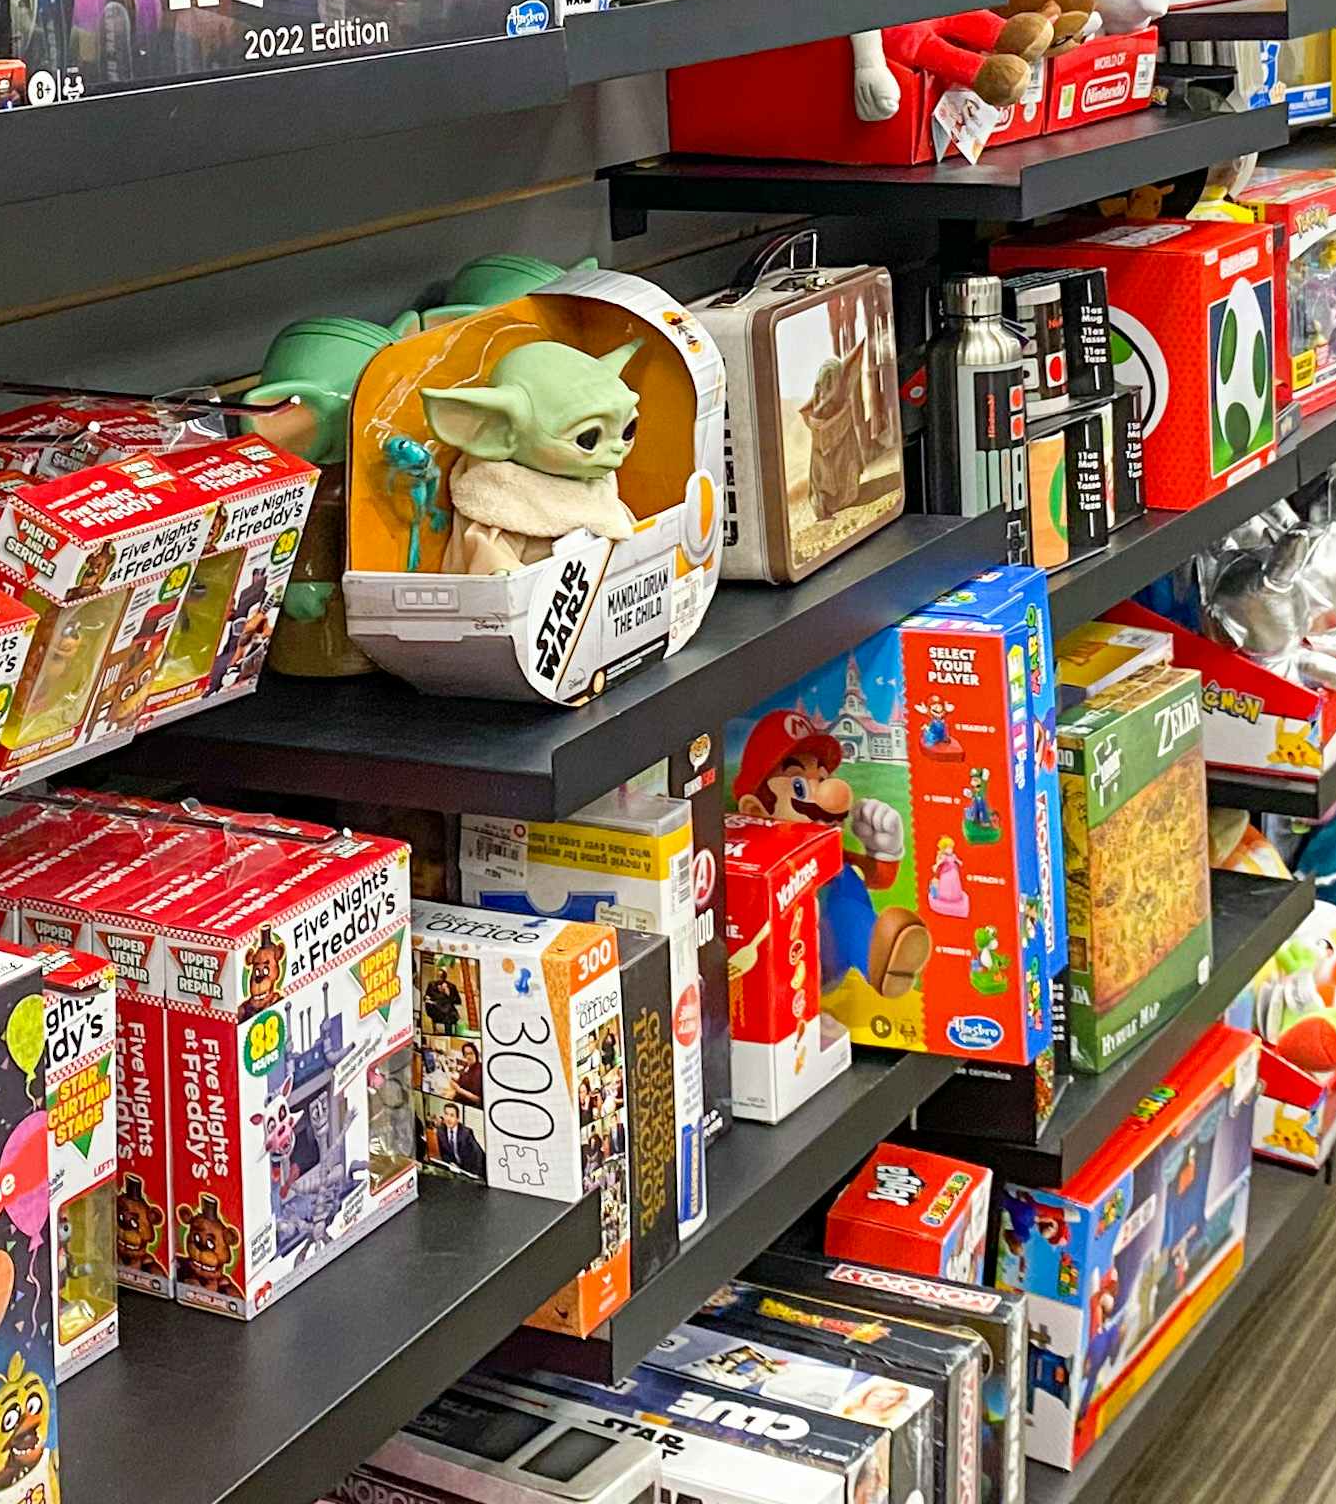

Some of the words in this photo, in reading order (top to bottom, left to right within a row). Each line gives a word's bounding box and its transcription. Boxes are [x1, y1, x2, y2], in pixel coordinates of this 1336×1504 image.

[244, 27, 306, 61] 2022
[310, 16, 389, 51] Edition
[1094, 56, 1111, 70] WORLD
[1112, 53, 1126, 66] OF
[1085, 76, 1129, 105] Nintendo
[1081, 314, 1103, 324] Mug
[1081, 335, 1106, 344] Tasse
[1084, 355, 1106, 363] Taza
[19, 519, 58, 550] PARTS
[5, 537, 56, 579] SERVICE
[607, 567, 669, 617] MANDALORIAN
[536, 560, 581, 672] STAR
[540, 566, 589, 680] WARS
[614, 610, 632, 637] THE
[635, 597, 662, 626] CHILD
[928, 647, 976, 662] SELECT
[945, 660, 973, 674] YOUR
[927, 671, 980, 687] PLAYER
[1155, 695, 1201, 757] ZELDA
[776, 859, 819, 908] Yahtzee
[293, 911, 330, 949] Five
[334, 868, 388, 916] Nights
[290, 959, 306, 978] at
[309, 892, 396, 971] Freddy's
[425, 915, 540, 947] office
[180, 950, 219, 971] UPPER
[184, 967, 215, 983] VENT
[577, 940, 611, 981] 300
[178, 976, 222, 999] REPAIR
[250, 1017, 279, 1059] 88
[1101, 1022, 1138, 1058] HYRULE
[1140, 1001, 1162, 1031] MAP
[59, 1064, 99, 1098] STAR
[47, 1078, 111, 1131] CURTAIN
[54, 1107, 103, 1146] STAGE
[666, 1391, 810, 1441] CLUE
